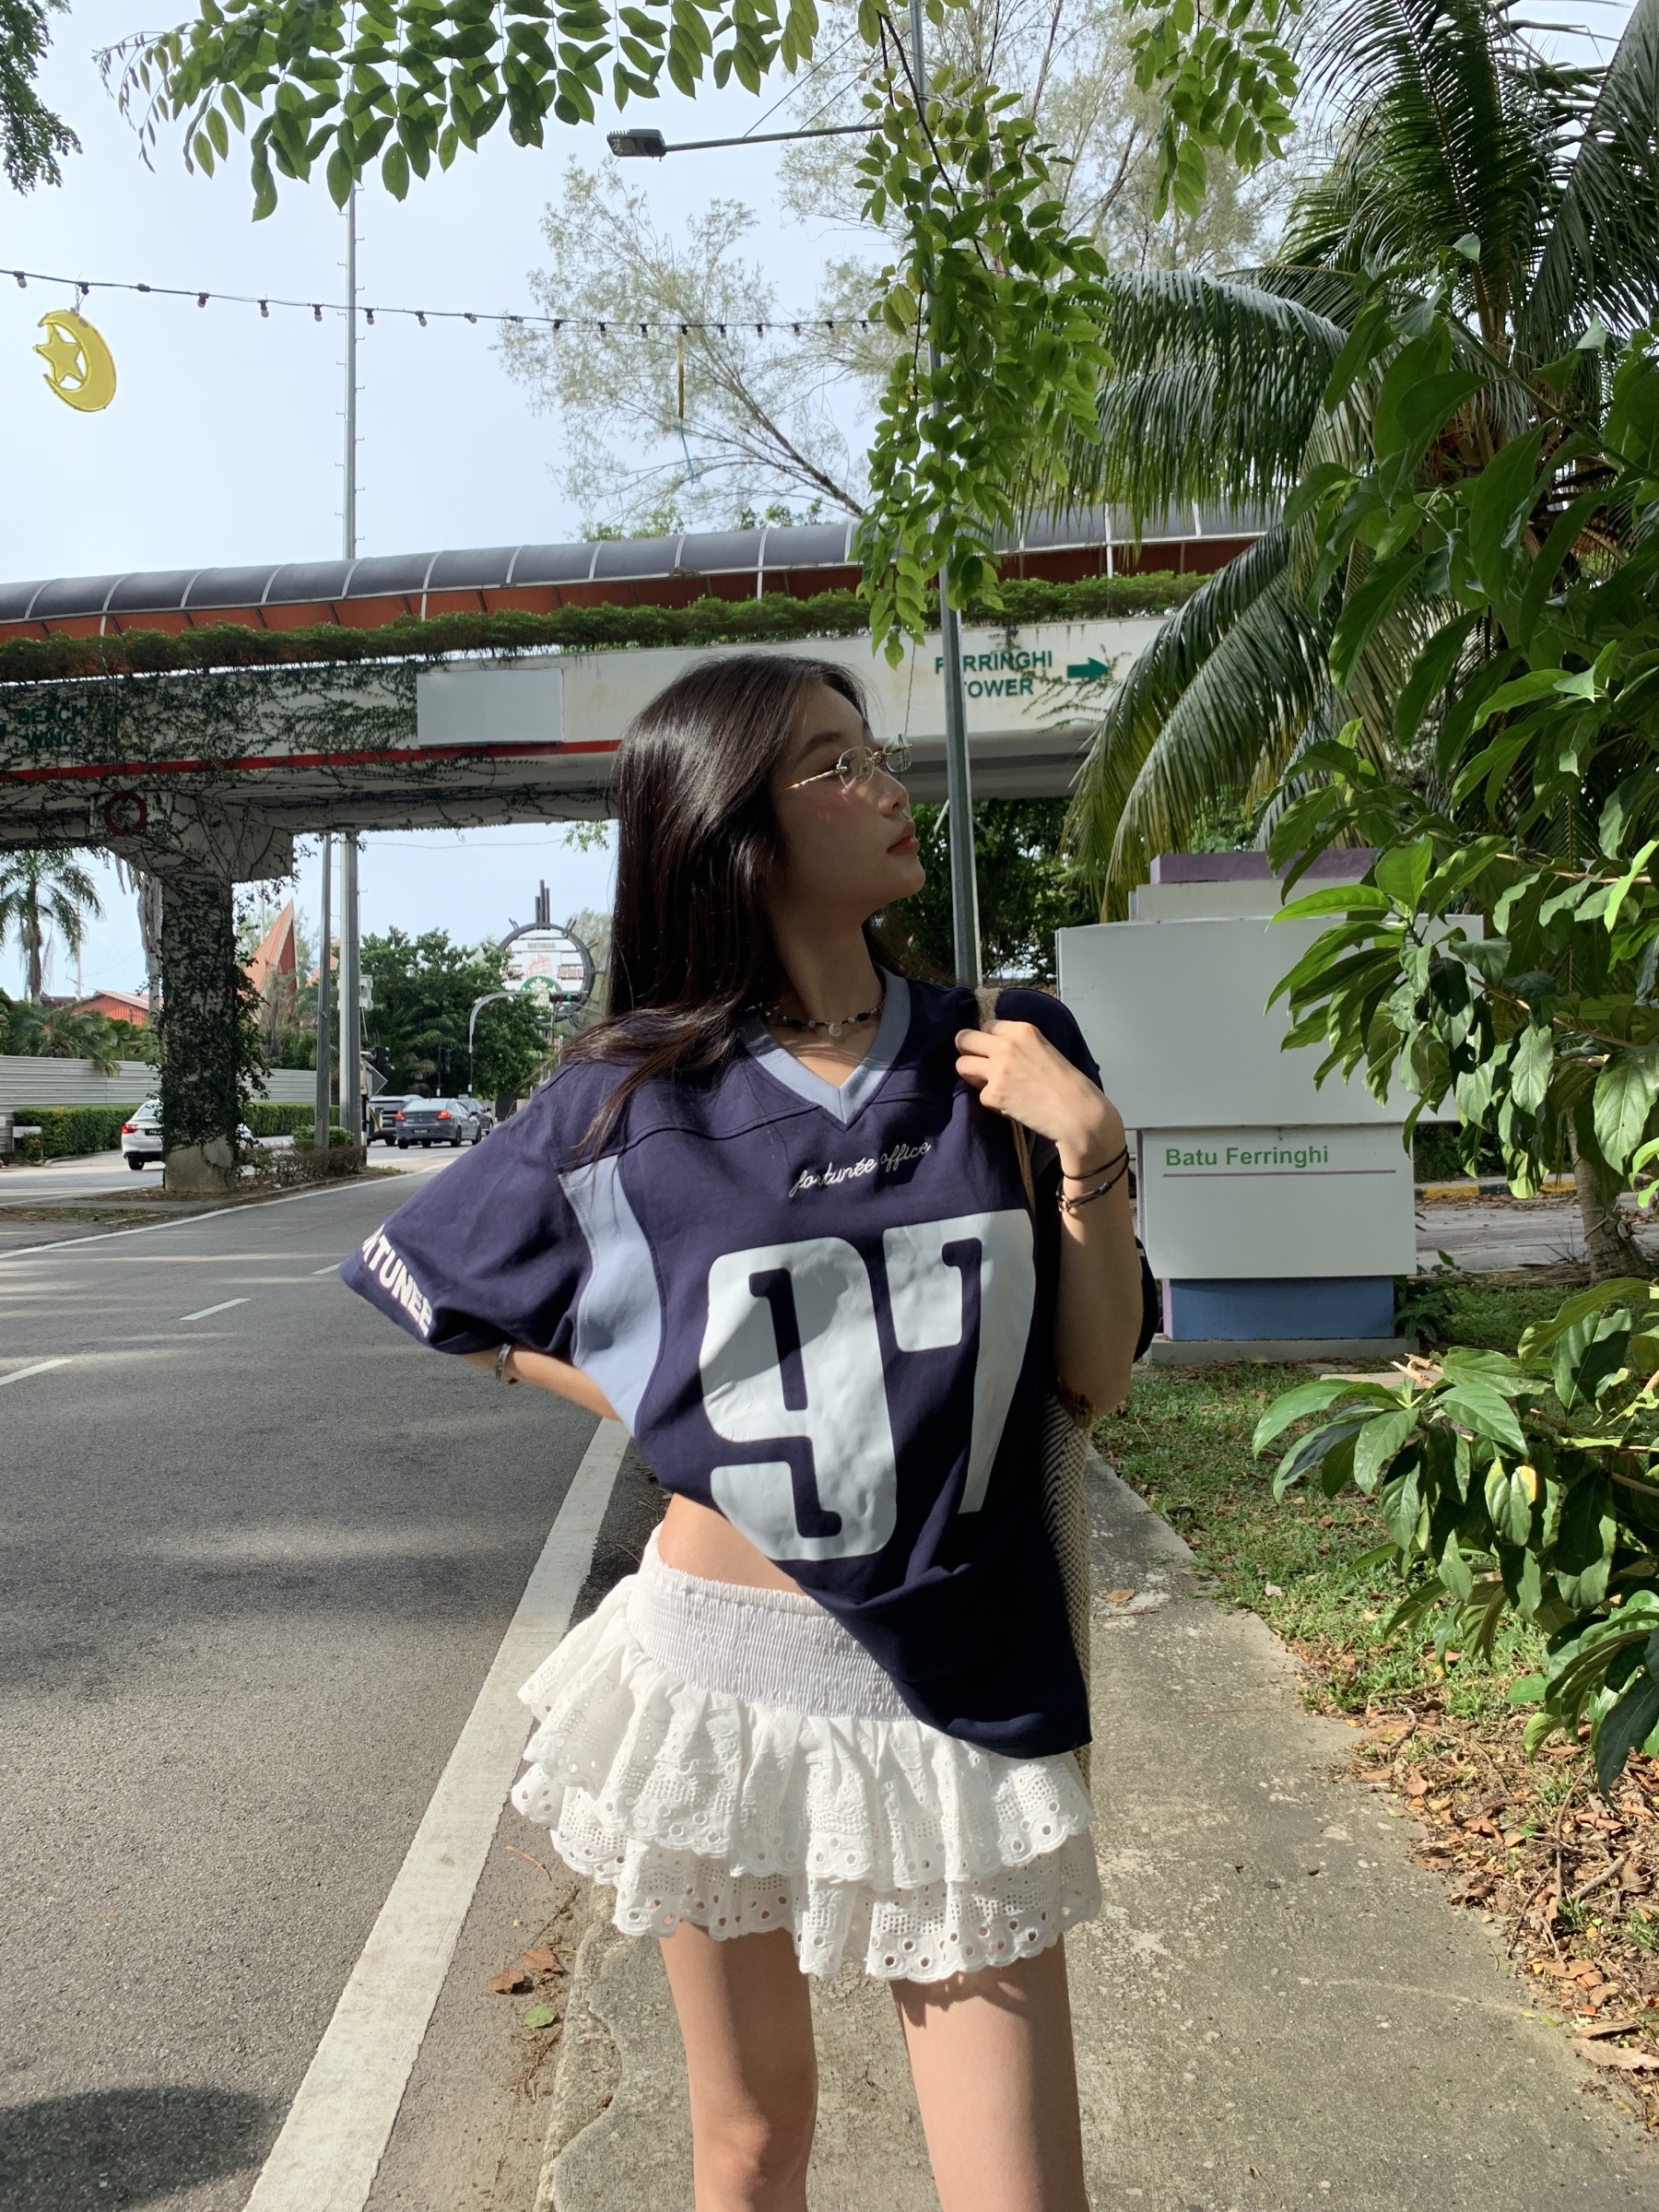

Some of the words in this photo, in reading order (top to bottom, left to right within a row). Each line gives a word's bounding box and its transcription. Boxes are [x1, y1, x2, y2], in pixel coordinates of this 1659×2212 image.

[935, 650, 1053, 675] FRRINGHI
[964, 677, 1033, 699] OWER
[788, 1157, 877, 1198] fortunée
[880, 1141, 932, 1172] office
[1165, 1148, 1218, 1167] Batu
[1226, 1146, 1329, 1169] Ferringhi
[699, 1208, 1037, 1561] 97
